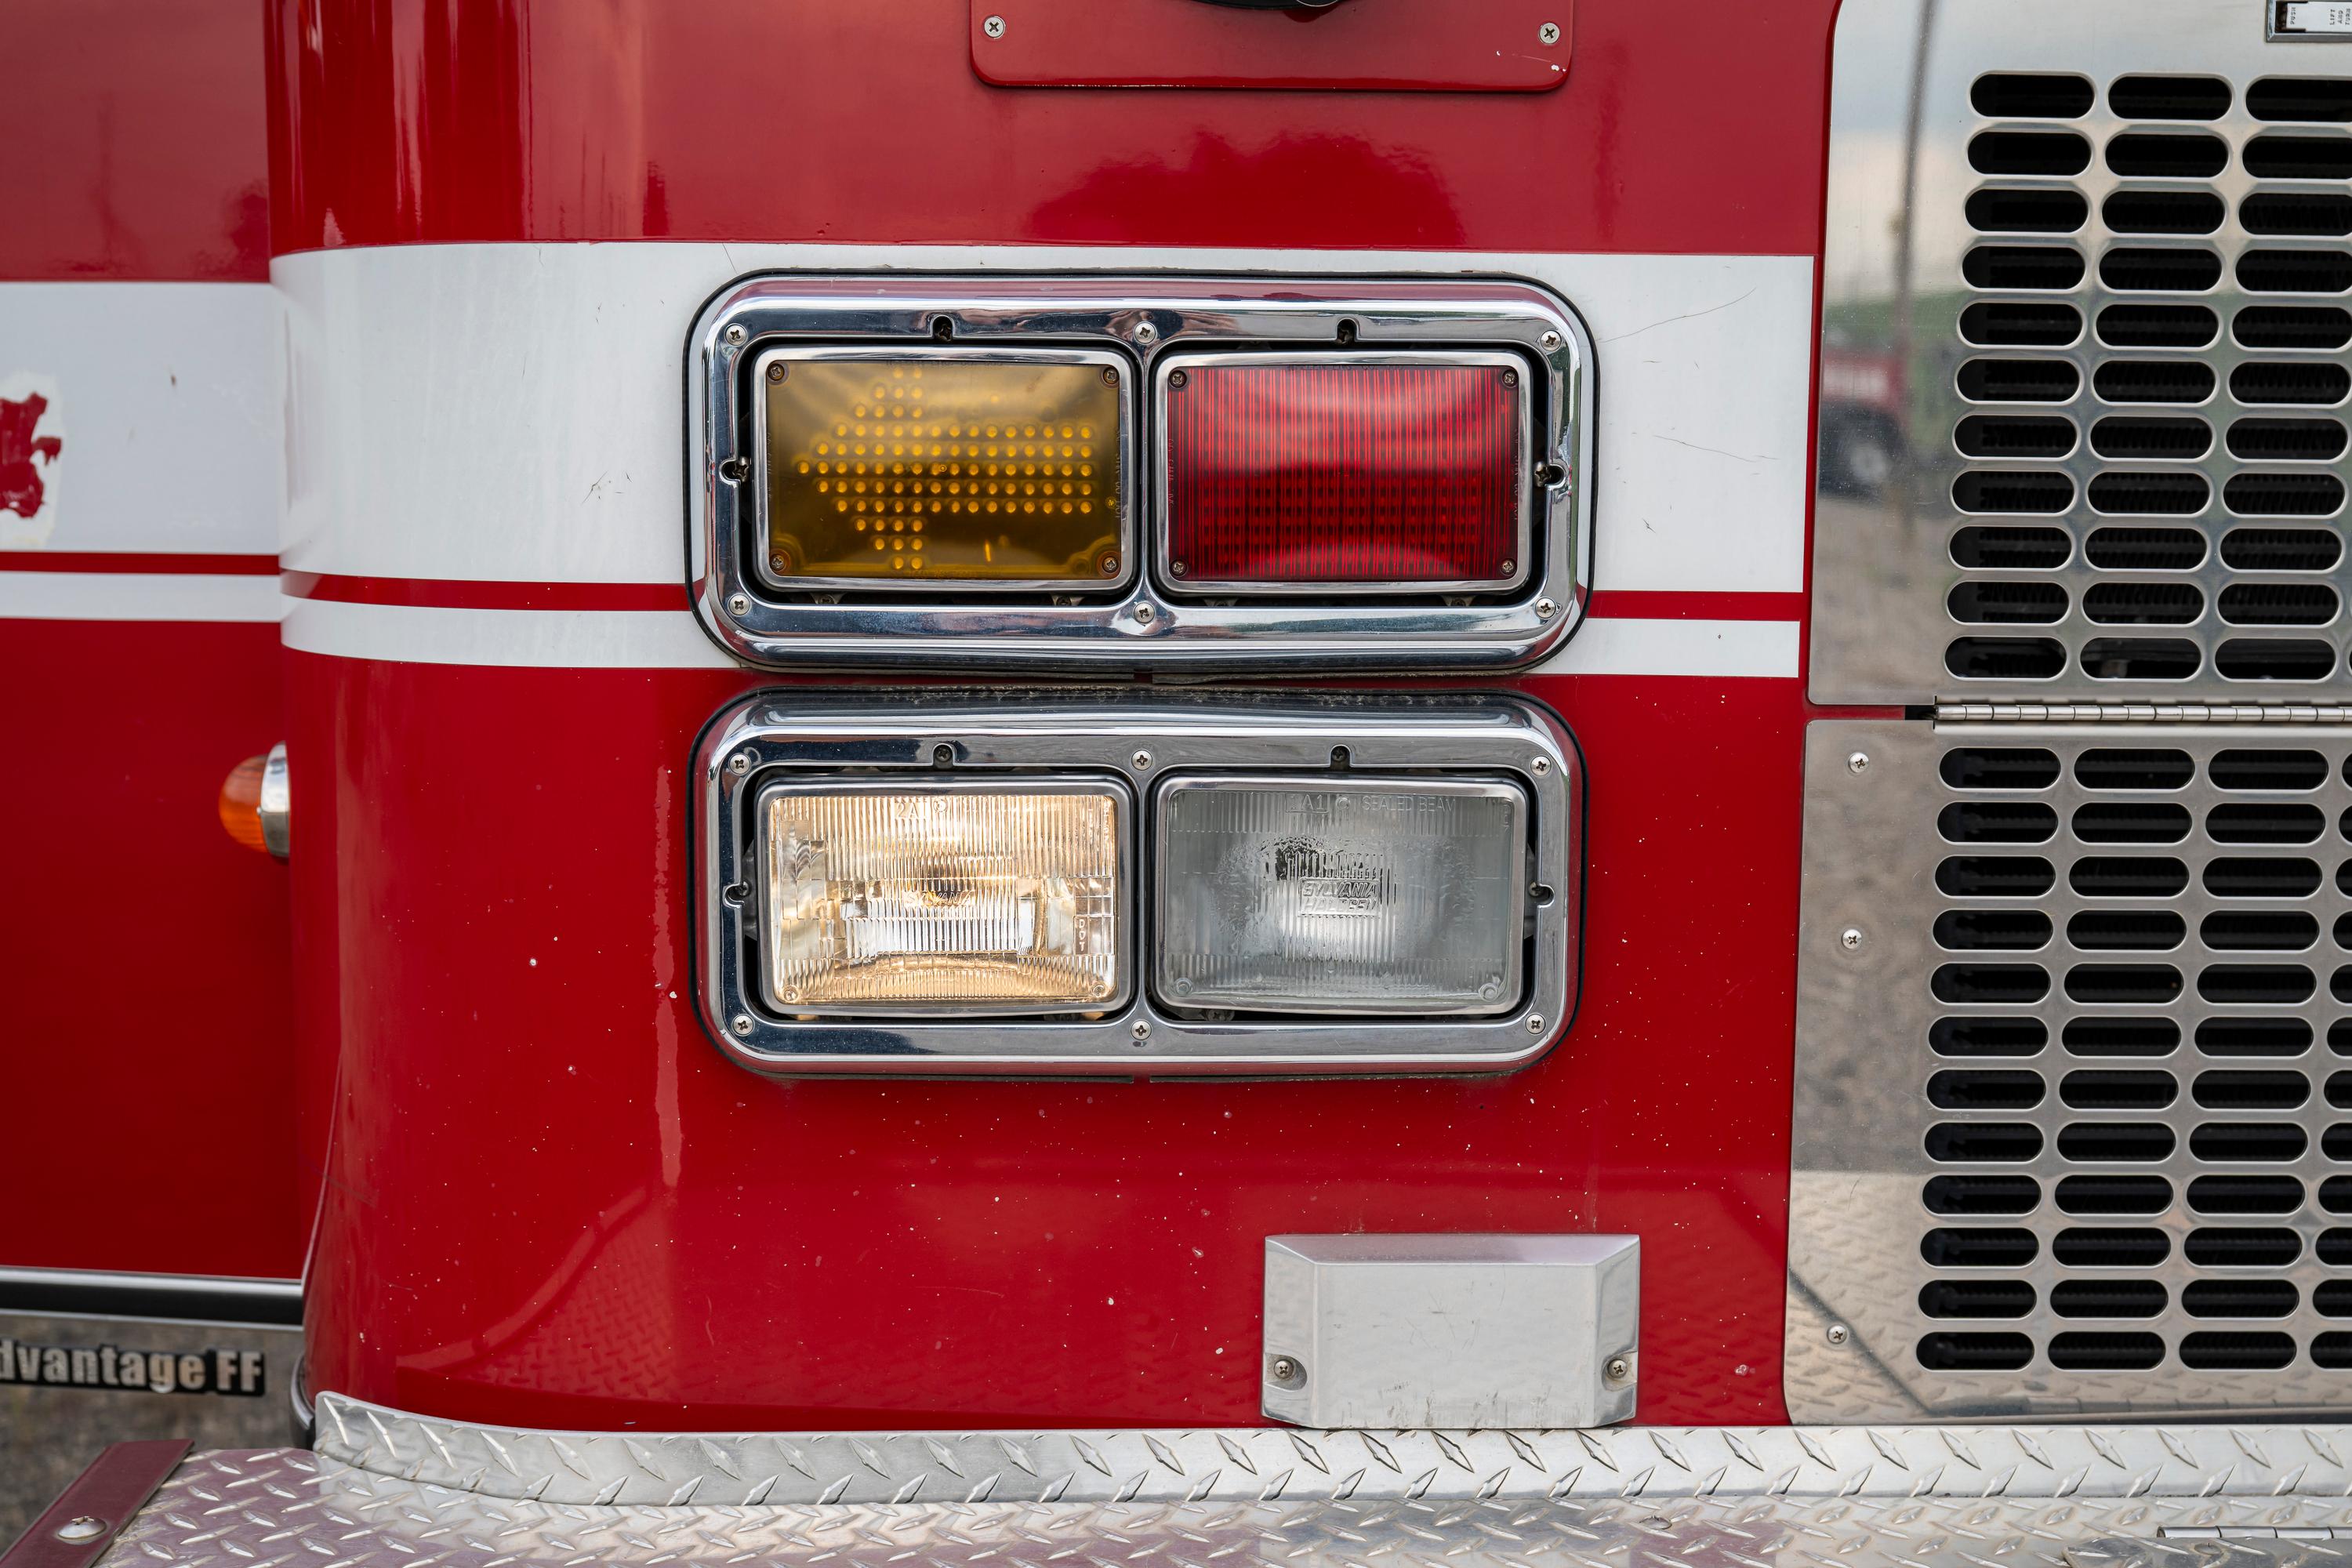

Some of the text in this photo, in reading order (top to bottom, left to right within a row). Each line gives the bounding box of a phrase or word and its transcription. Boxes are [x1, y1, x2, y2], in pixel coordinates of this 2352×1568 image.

[1362, 795, 1413, 811] SEALED
[1302, 881, 1377, 898] SYLVANIA
[216, 1350, 261, 1392] FF
